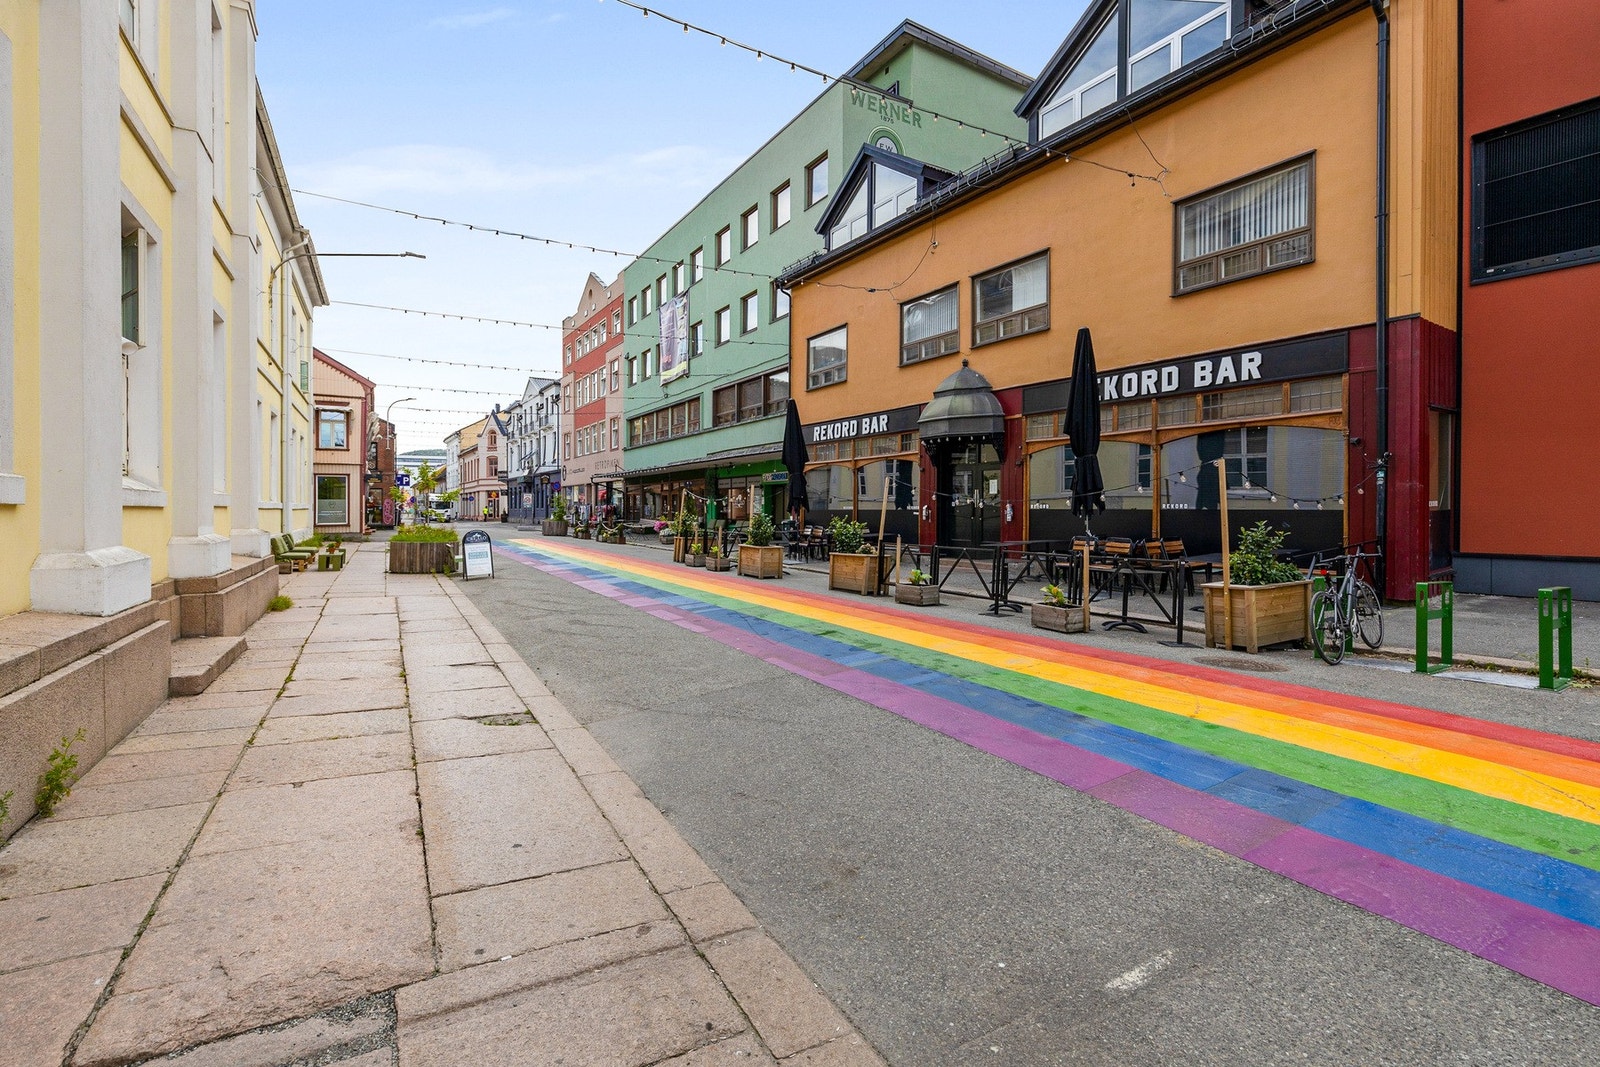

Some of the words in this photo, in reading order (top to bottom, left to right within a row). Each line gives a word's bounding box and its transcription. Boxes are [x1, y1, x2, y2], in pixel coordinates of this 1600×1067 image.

[850, 88, 922, 128] WERNER
[880, 115, 895, 124] 1875
[1097, 365, 1179, 401] KORD
[1194, 351, 1263, 388] BAR
[813, 419, 859, 442] REKORD
[861, 414, 889, 435] BAR
[403, 476, 410, 485] P
